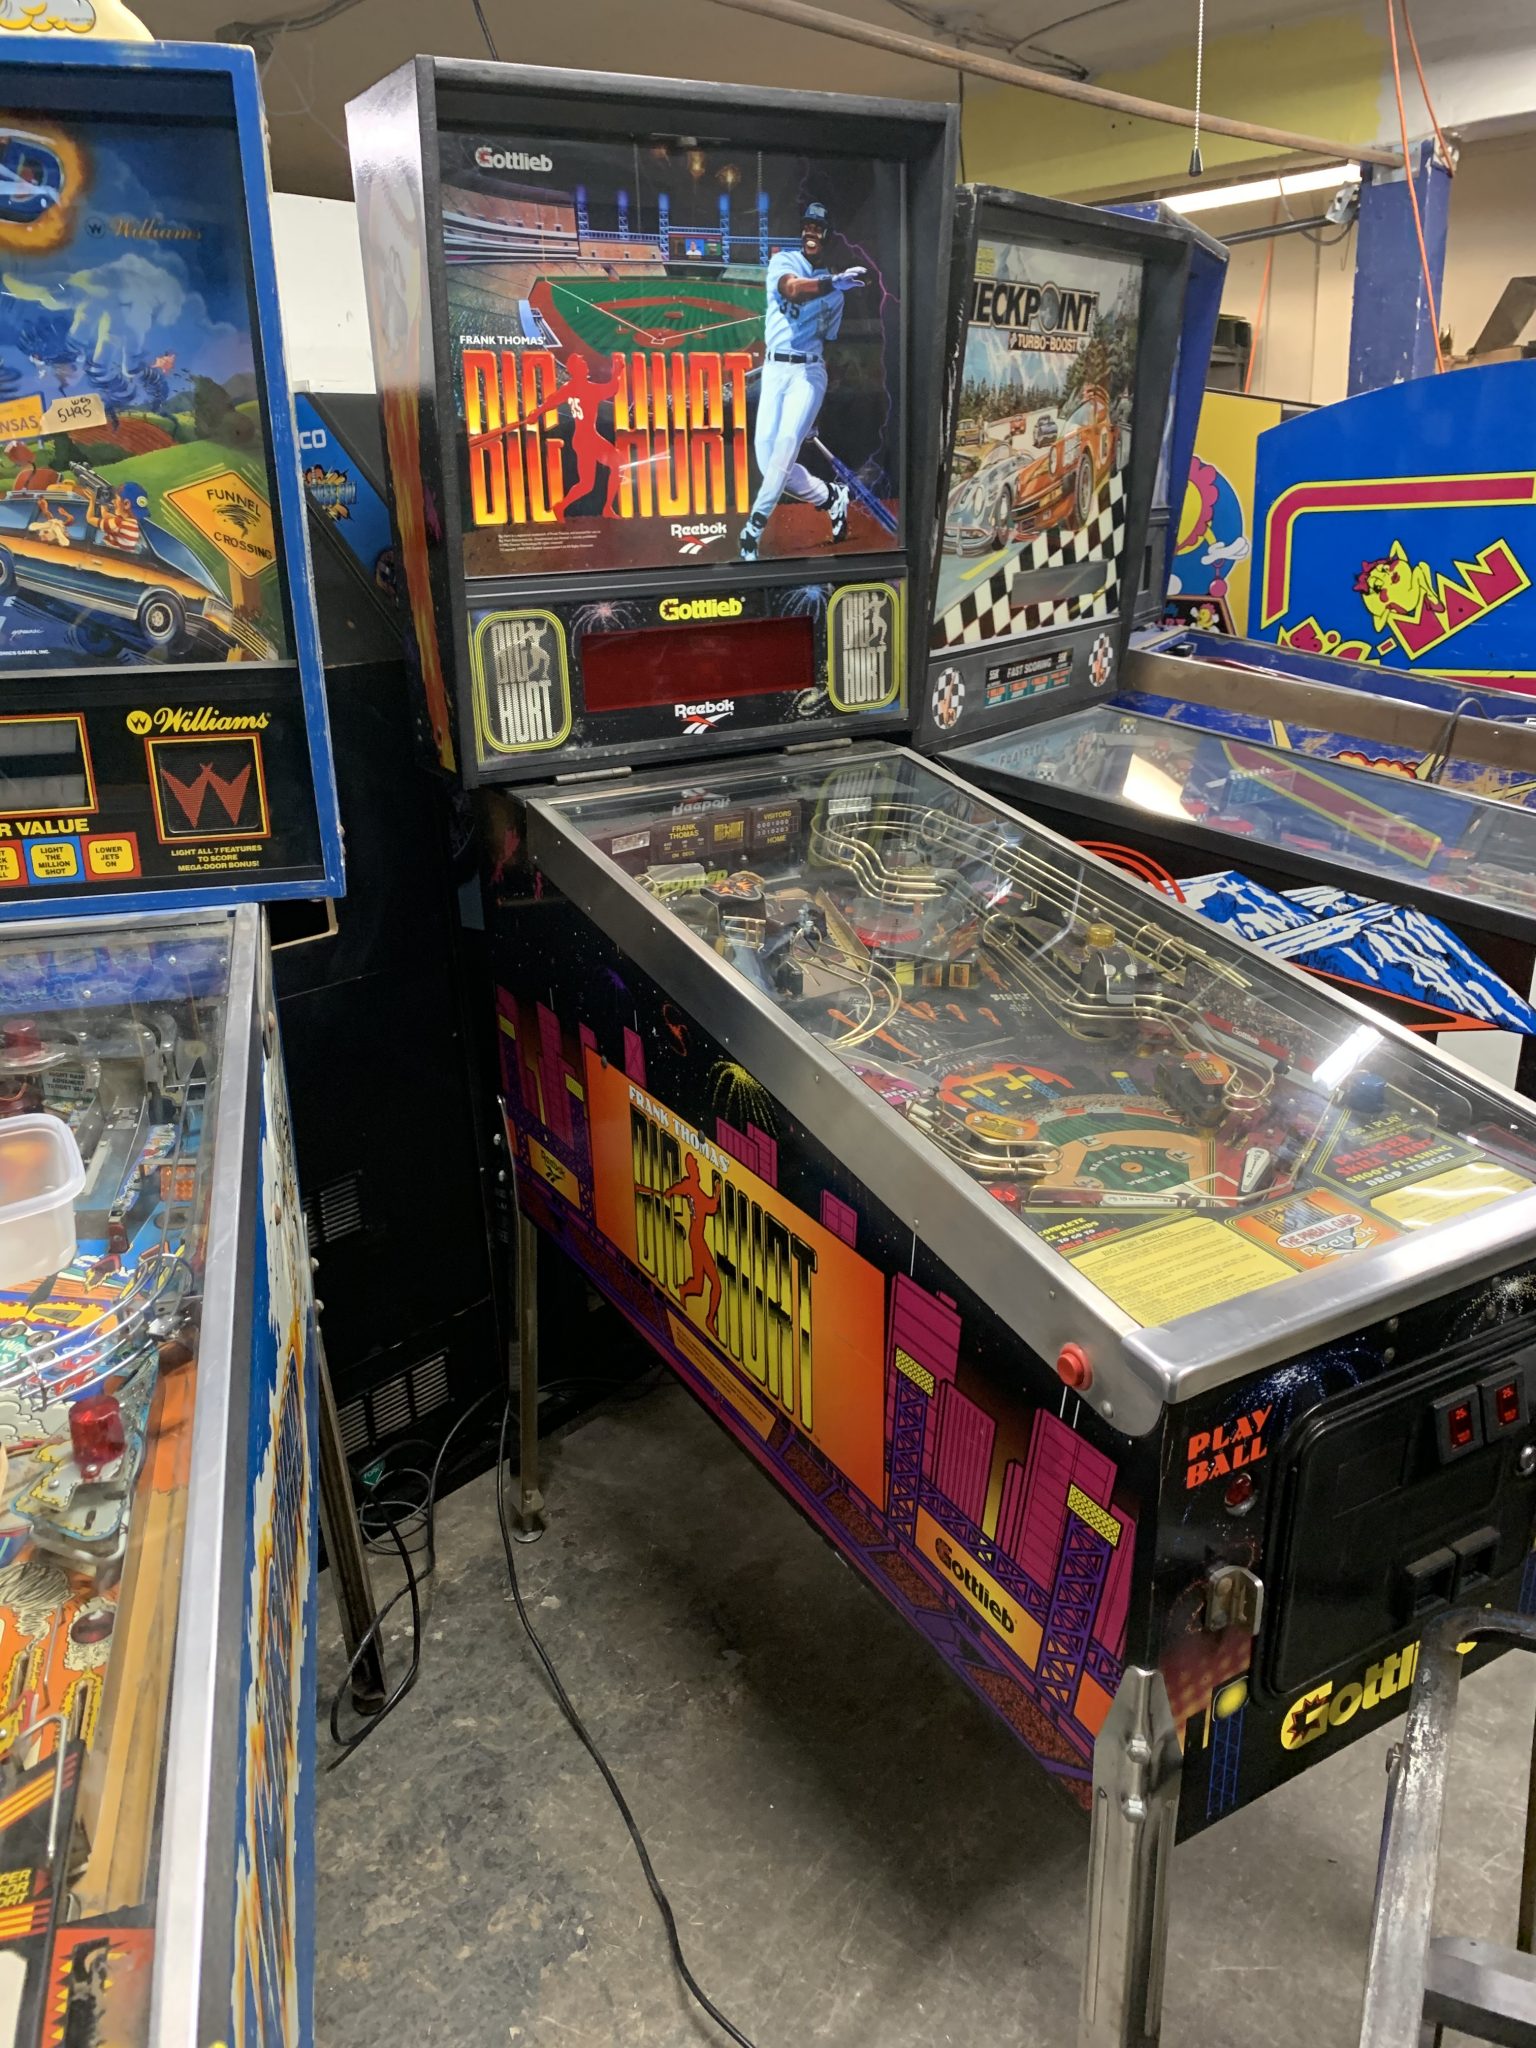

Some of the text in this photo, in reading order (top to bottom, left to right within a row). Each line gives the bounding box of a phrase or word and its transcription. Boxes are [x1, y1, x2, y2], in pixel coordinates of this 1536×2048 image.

[475, 146, 553, 172] Gottlieb
[972, 282, 1098, 332] ECKPOINT
[459, 335, 496, 345] FRANK
[567, 397, 584, 420] 35
[0, 415, 39, 433] NSAS
[299, 429, 327, 449] CO
[462, 350, 753, 525] BIG HURT
[206, 488, 262, 518] FUNNEL
[670, 522, 728, 537] Reebok
[213, 531, 273, 561] CROSSING
[659, 597, 743, 621] Gottlieb
[843, 645, 887, 704] HURT
[498, 680, 553, 744] HURT
[674, 699, 735, 719] Reebok
[154, 707, 269, 733] Williams
[763, 810, 792, 820] VISITORS
[0, 818, 90, 837] R VALUE
[668, 829, 699, 840] THOMAS
[671, 823, 696, 833] FRANK
[767, 834, 787, 844] HOME
[40, 846, 64, 854] LIGHT
[95, 846, 123, 854] LOWER
[171, 849, 196, 857] LIGHT
[197, 847, 213, 855] ALL
[220, 845, 262, 854] FEATURES
[210, 854, 238, 862] SCORE
[38, 861, 70, 869] MILLION
[178, 863, 227, 872] MEGA-DOOR
[629, 1085, 669, 1128] FRANK
[1346, 1144, 1453, 1184] SHOOT FLASHING
[1365, 1152, 1455, 1187] DROP TARGET
[1045, 1232, 1059, 1242] LL
[1071, 1233, 1083, 1241] GO
[1300, 1222, 1333, 1241] PINBALL
[1300, 1226, 1378, 1257] Reebok
[711, 1169, 818, 1433] HURT
[1188, 1404, 1273, 1461] PLAY
[1186, 1437, 1268, 1489] BALL
[935, 1537, 1015, 1634] Gottlieb
[1281, 1639, 1424, 1750] Gottli
